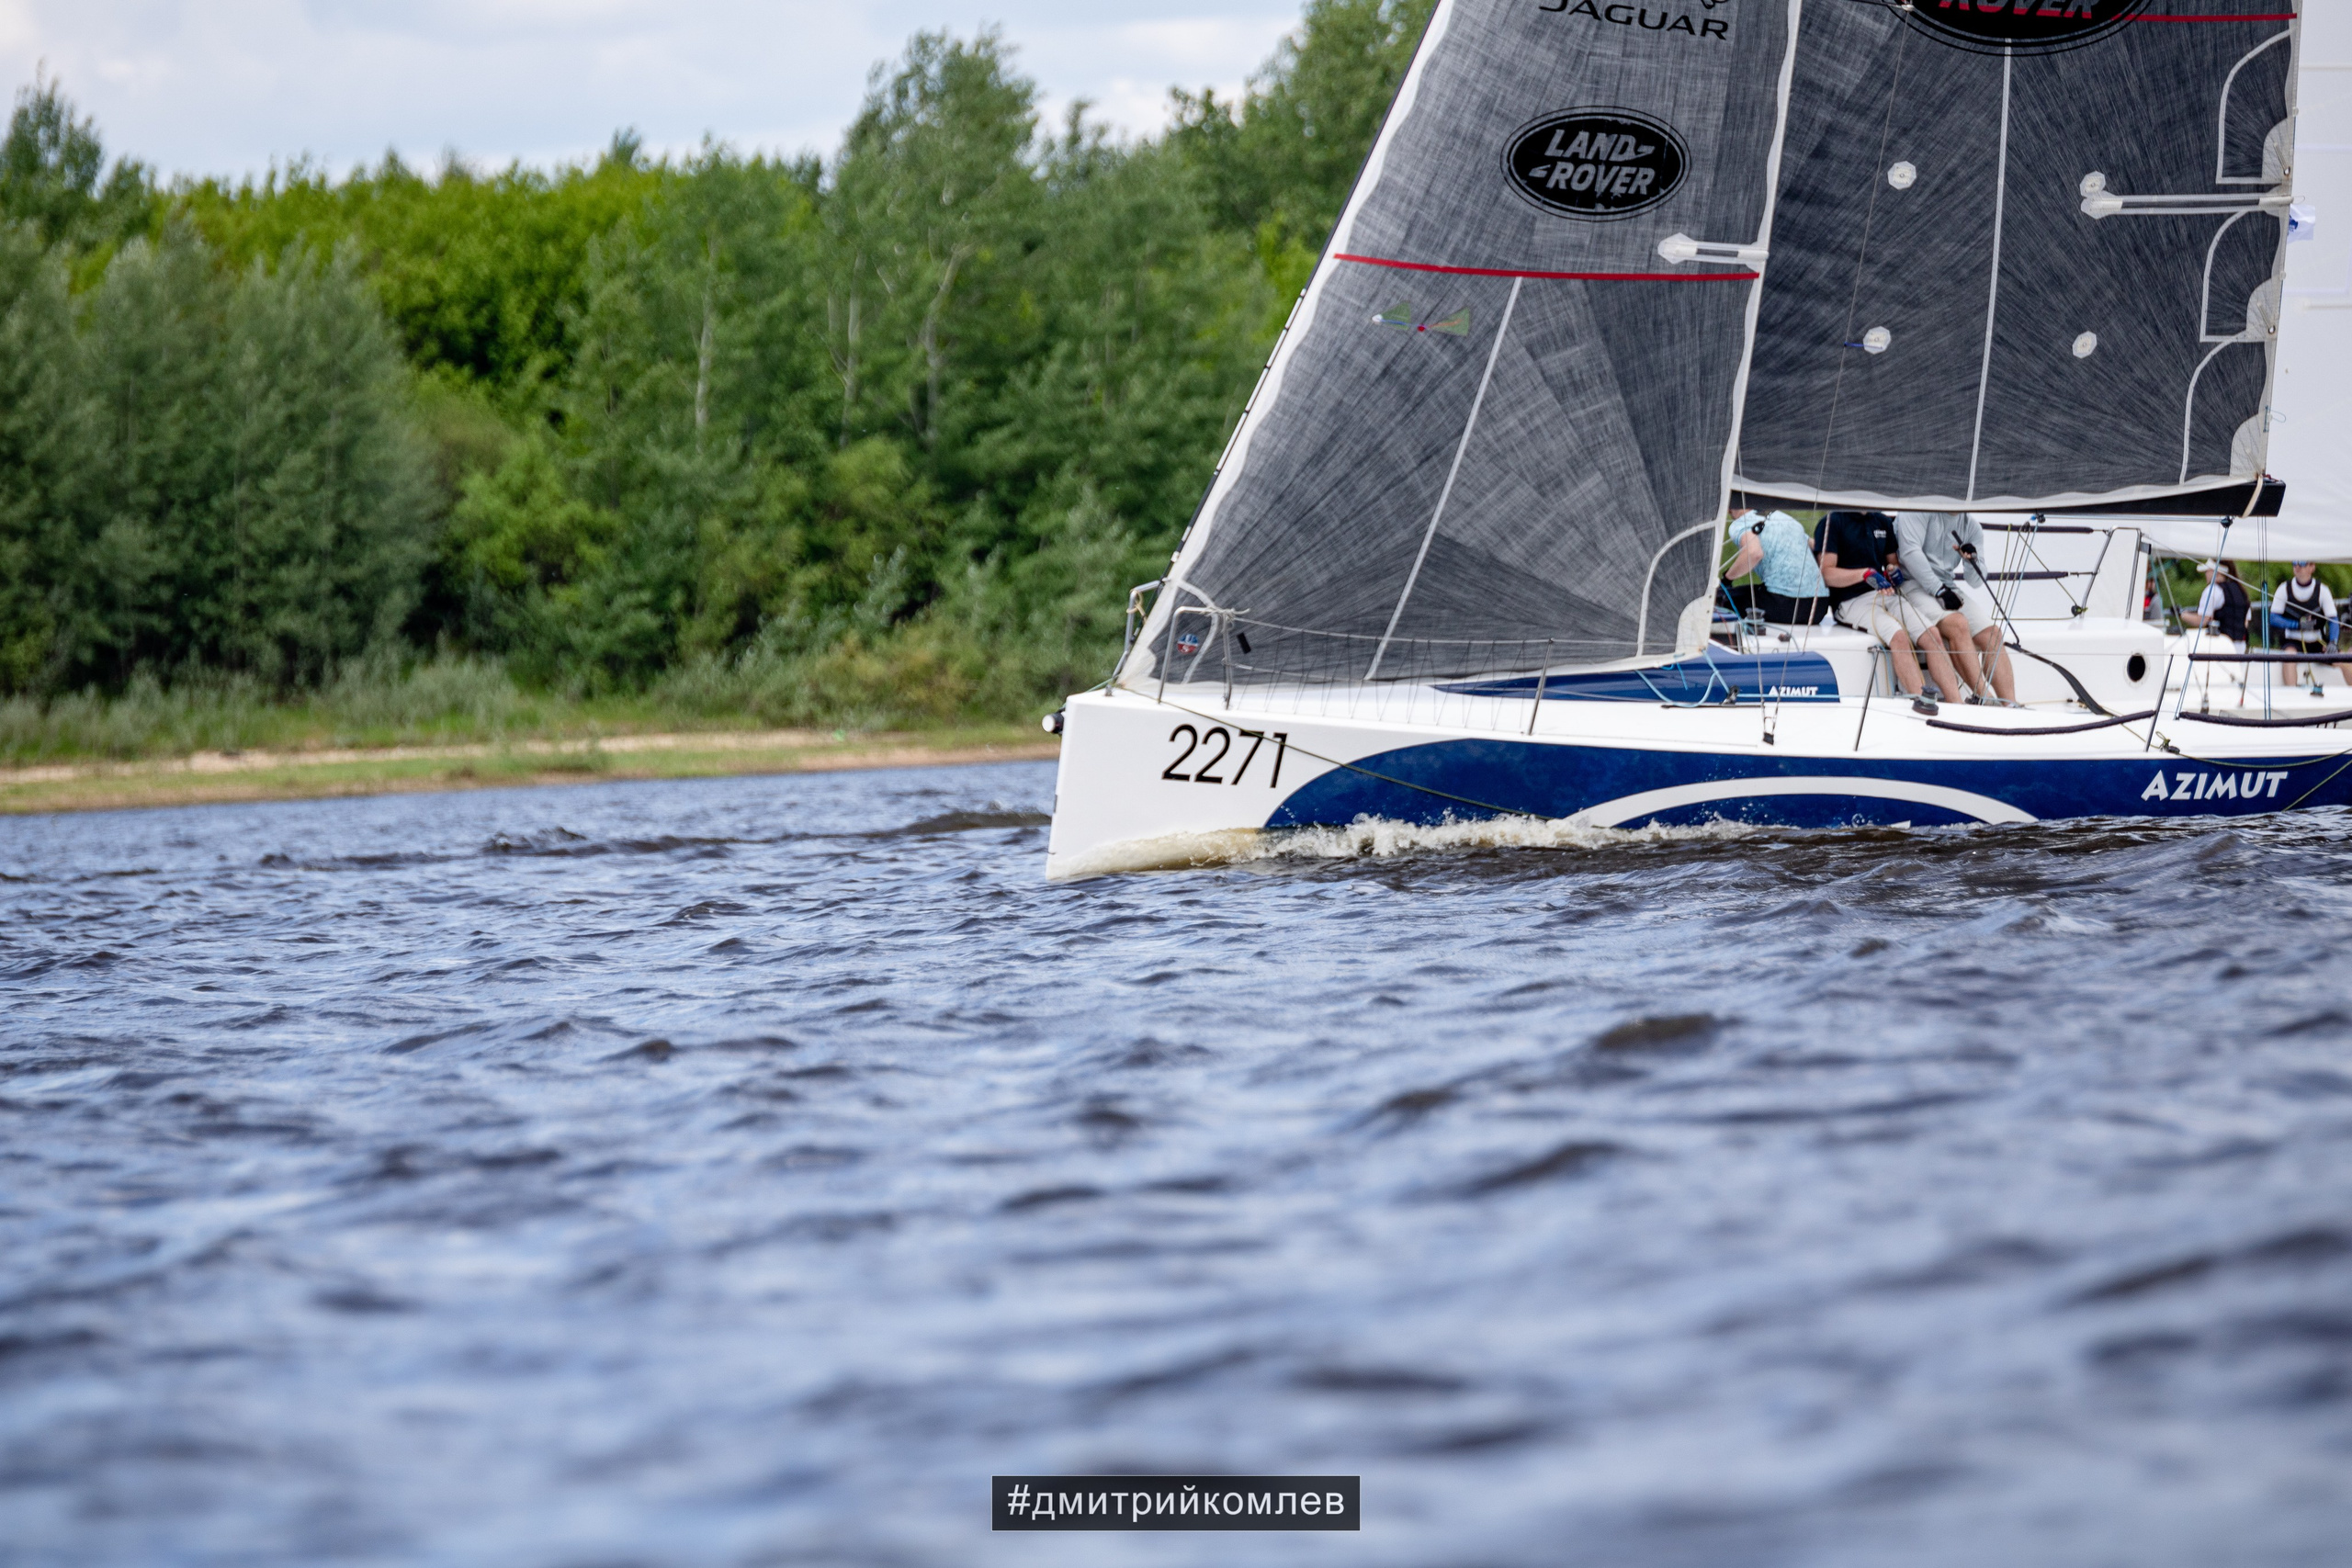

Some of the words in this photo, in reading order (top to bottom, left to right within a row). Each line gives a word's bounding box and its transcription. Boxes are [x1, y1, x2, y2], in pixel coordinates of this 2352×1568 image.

[1538, 0, 1729, 40] JAGUAR
[1544, 129, 1639, 163] LAND
[1545, 161, 1656, 196] ROVER
[1768, 684, 1819, 697] AZIMUT
[1161, 723, 1288, 789] 2271
[2141, 769, 2289, 801] AZIMUT
